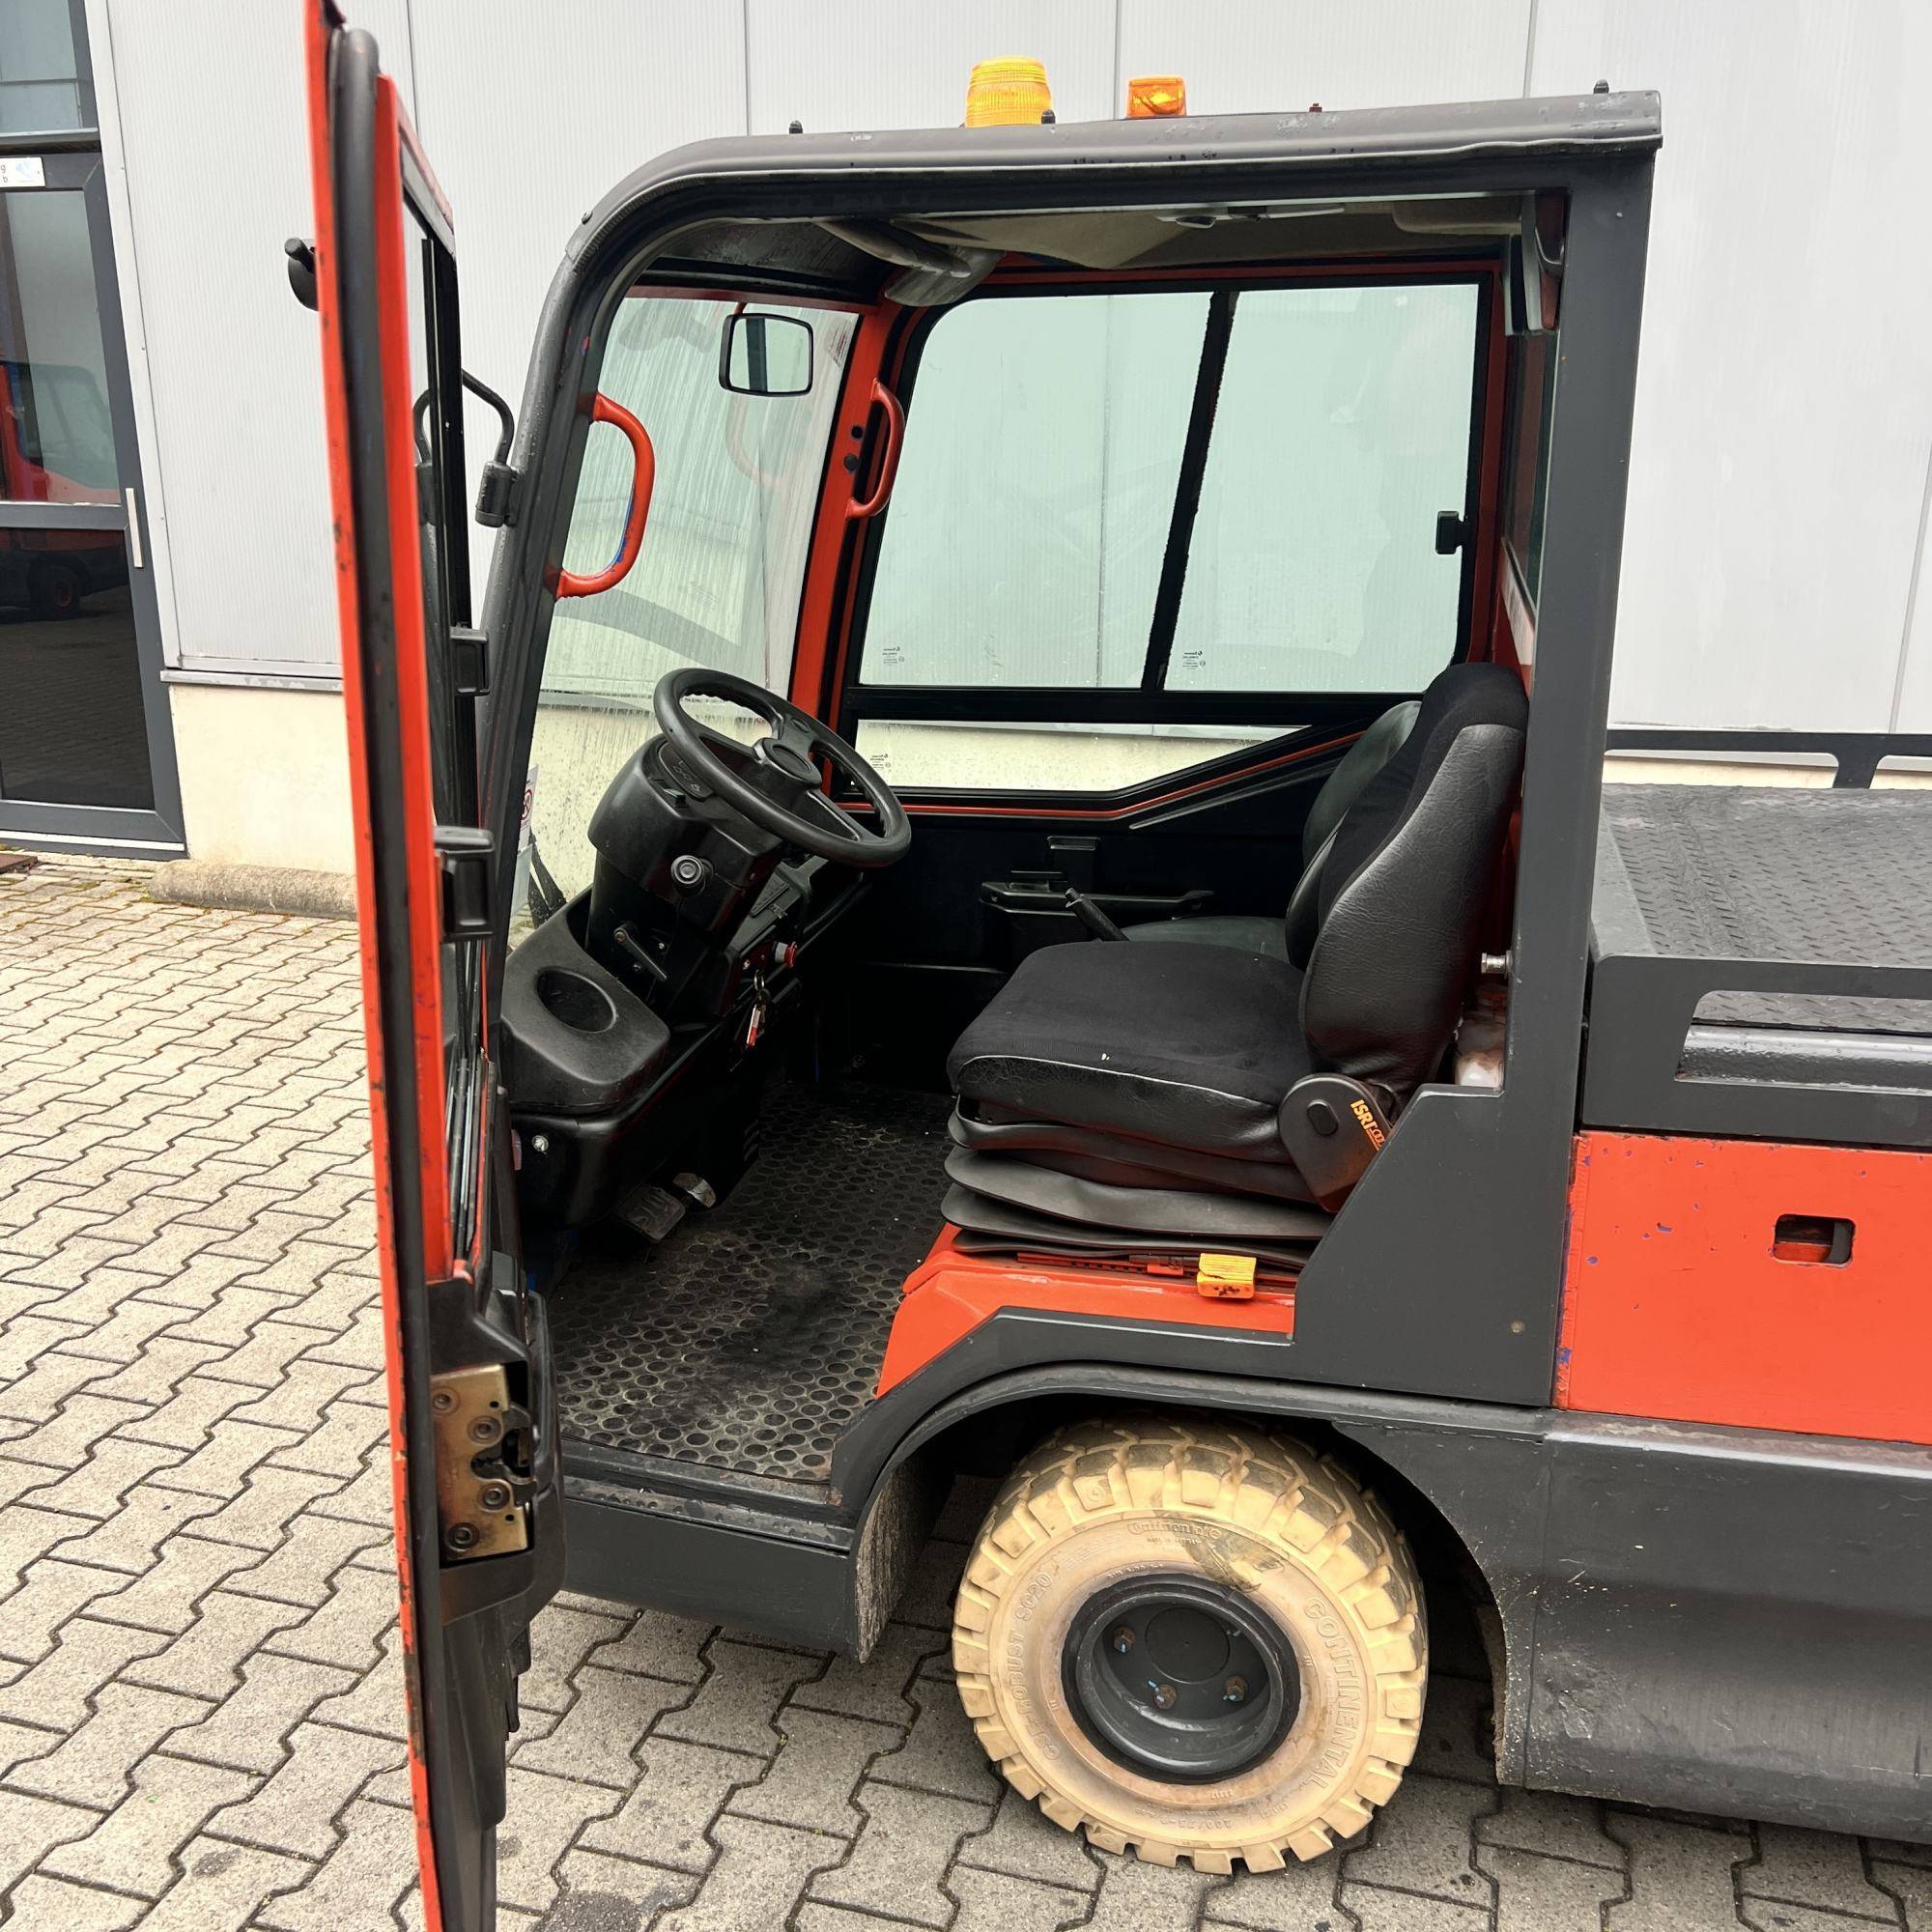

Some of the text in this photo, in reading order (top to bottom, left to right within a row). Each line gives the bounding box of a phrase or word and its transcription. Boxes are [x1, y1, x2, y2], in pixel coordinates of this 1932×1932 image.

[1350, 1099, 1378, 1130] ISRI
[1014, 1572, 1052, 1622] SC20
[1304, 1597, 1361, 1789] CONTINENTAL
